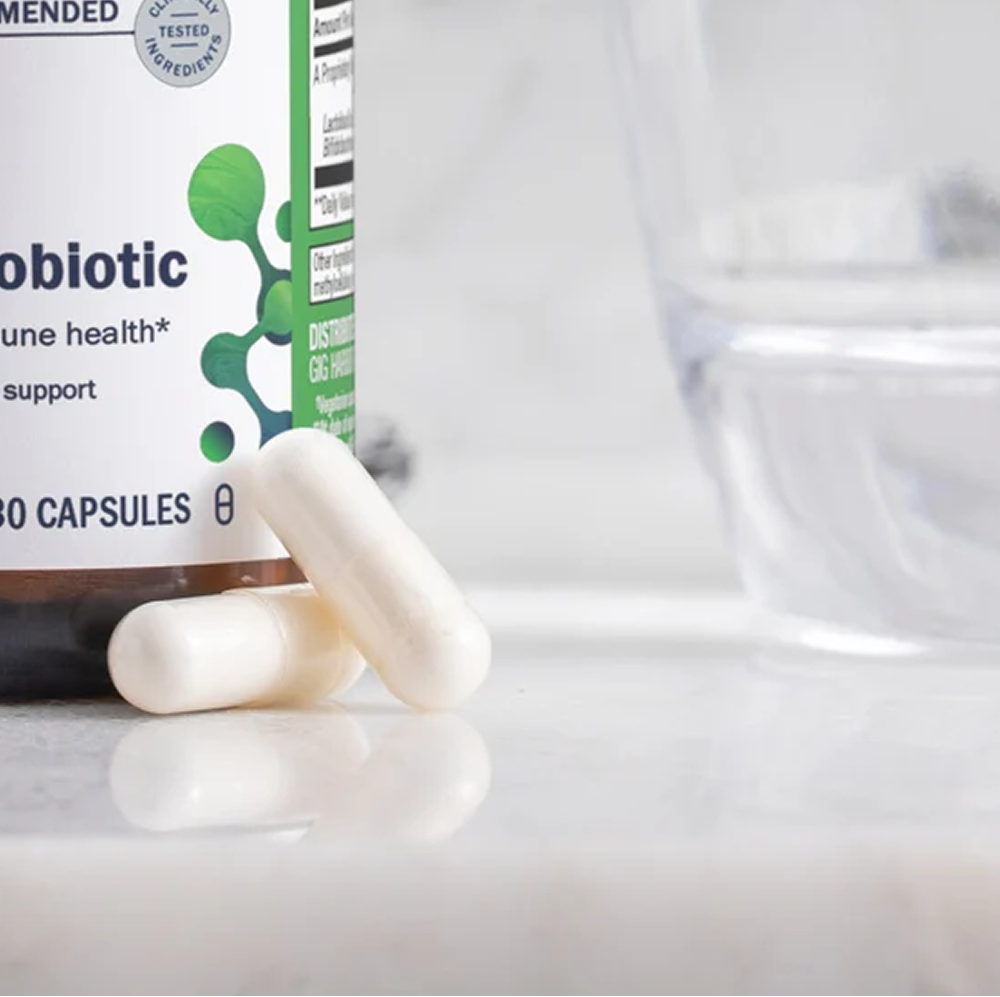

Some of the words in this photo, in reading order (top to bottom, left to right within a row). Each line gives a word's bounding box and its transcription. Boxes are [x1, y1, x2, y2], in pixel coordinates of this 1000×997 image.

[159, 24, 210, 38] TESTED
[145, 34, 222, 77] INGREDIENTS
[3, 380, 97, 405] support
[37, 492, 192, 529] CAPSULES
